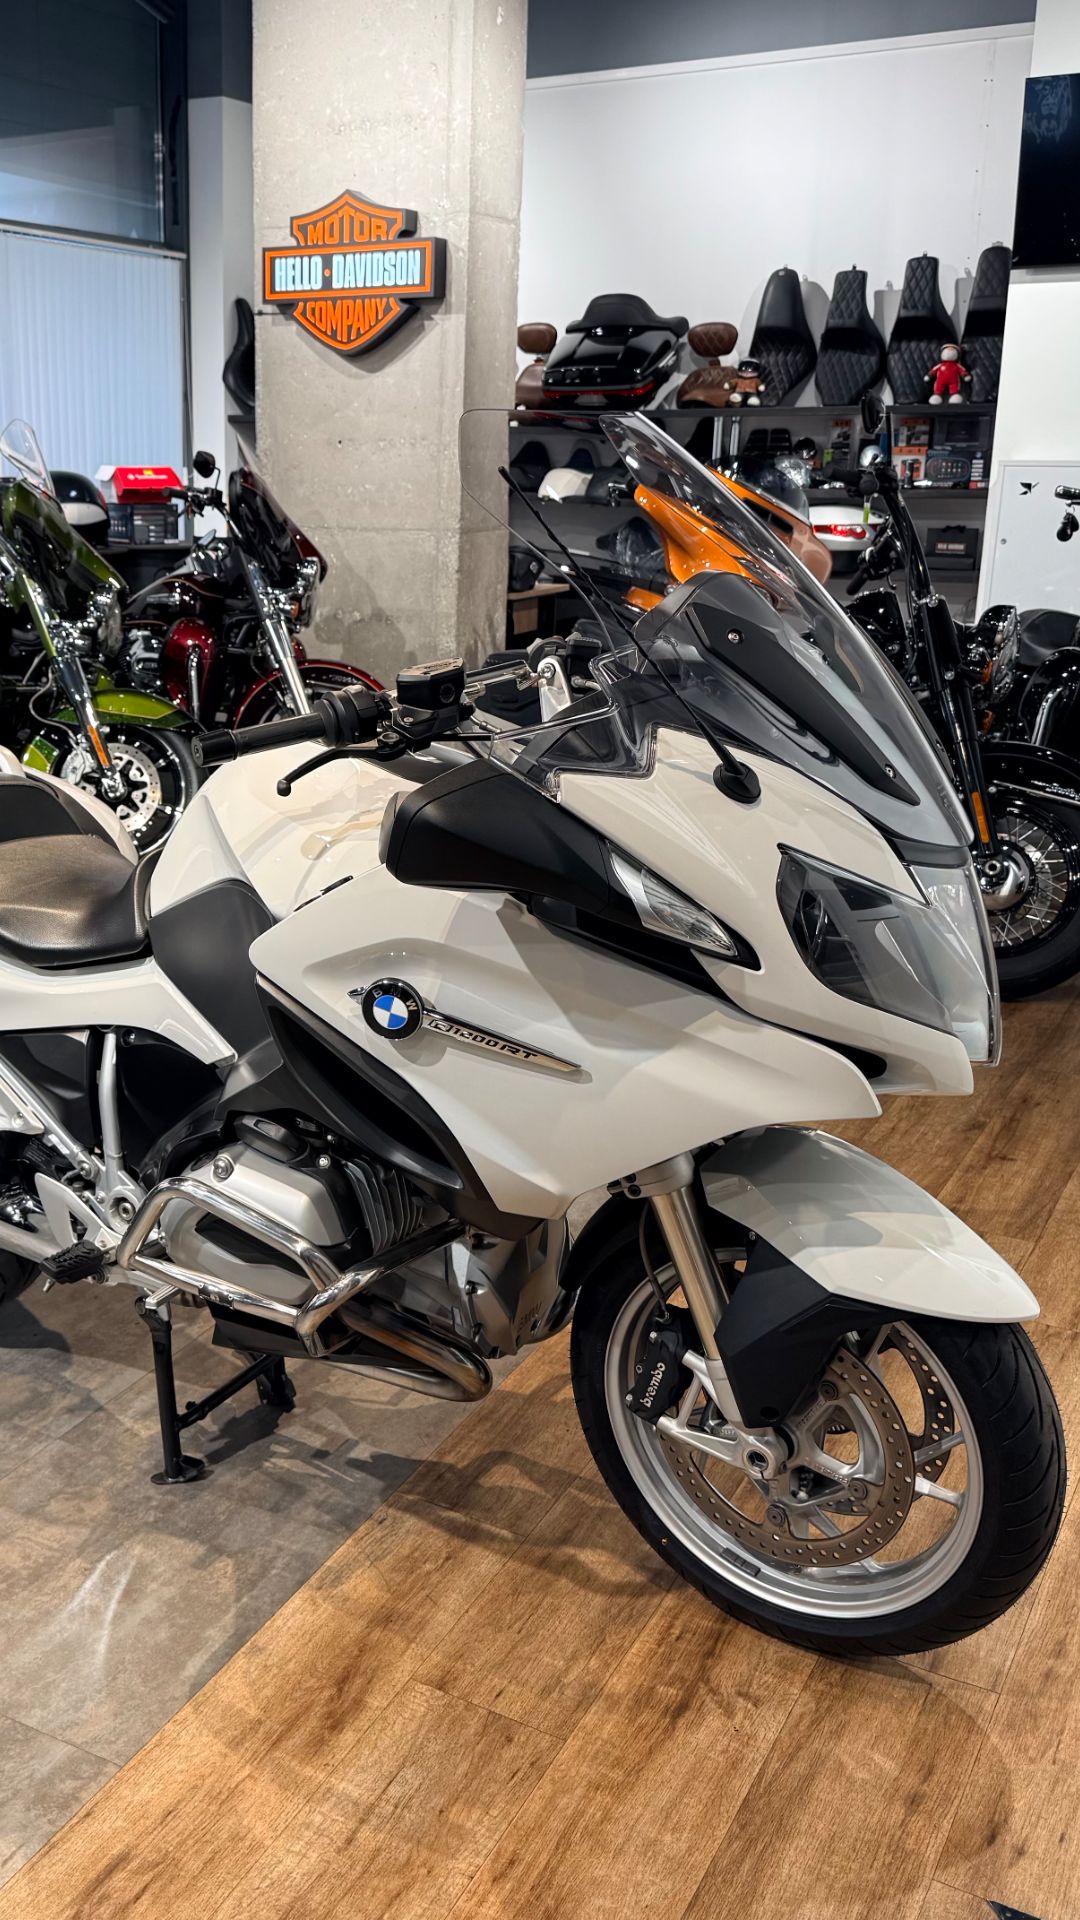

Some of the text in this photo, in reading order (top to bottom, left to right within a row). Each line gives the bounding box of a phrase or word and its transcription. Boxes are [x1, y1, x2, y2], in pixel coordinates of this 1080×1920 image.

[307, 205, 388, 245] MOTOR
[274, 249, 421, 292] HELLO DAVIDSON
[306, 297, 388, 343] COMPANY
[371, 985, 418, 1011] BMW
[639, 1361, 666, 1409] brembo
